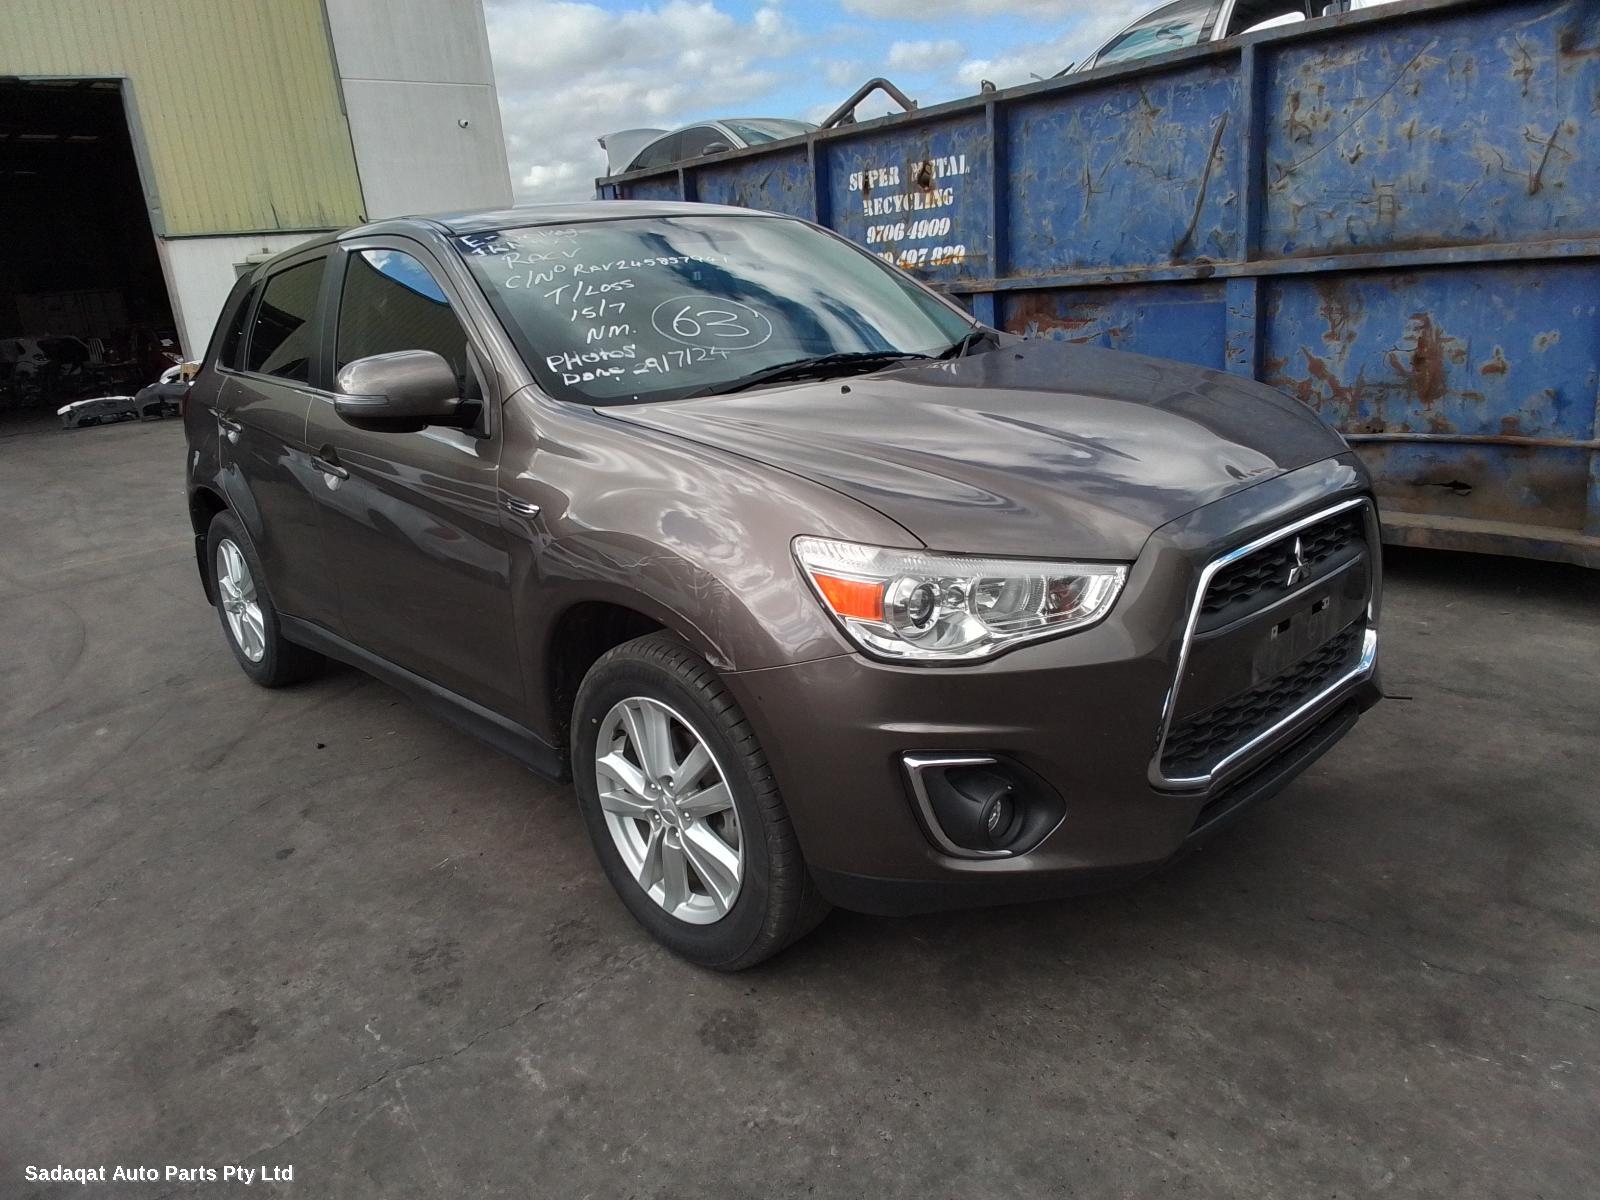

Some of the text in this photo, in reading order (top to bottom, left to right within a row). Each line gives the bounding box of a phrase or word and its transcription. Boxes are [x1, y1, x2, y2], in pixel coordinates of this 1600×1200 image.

[863, 187, 954, 217] RECYCLING
[866, 222, 905, 244] 9706
[571, 299, 626, 322] 15/7
[672, 306, 750, 337] 63
